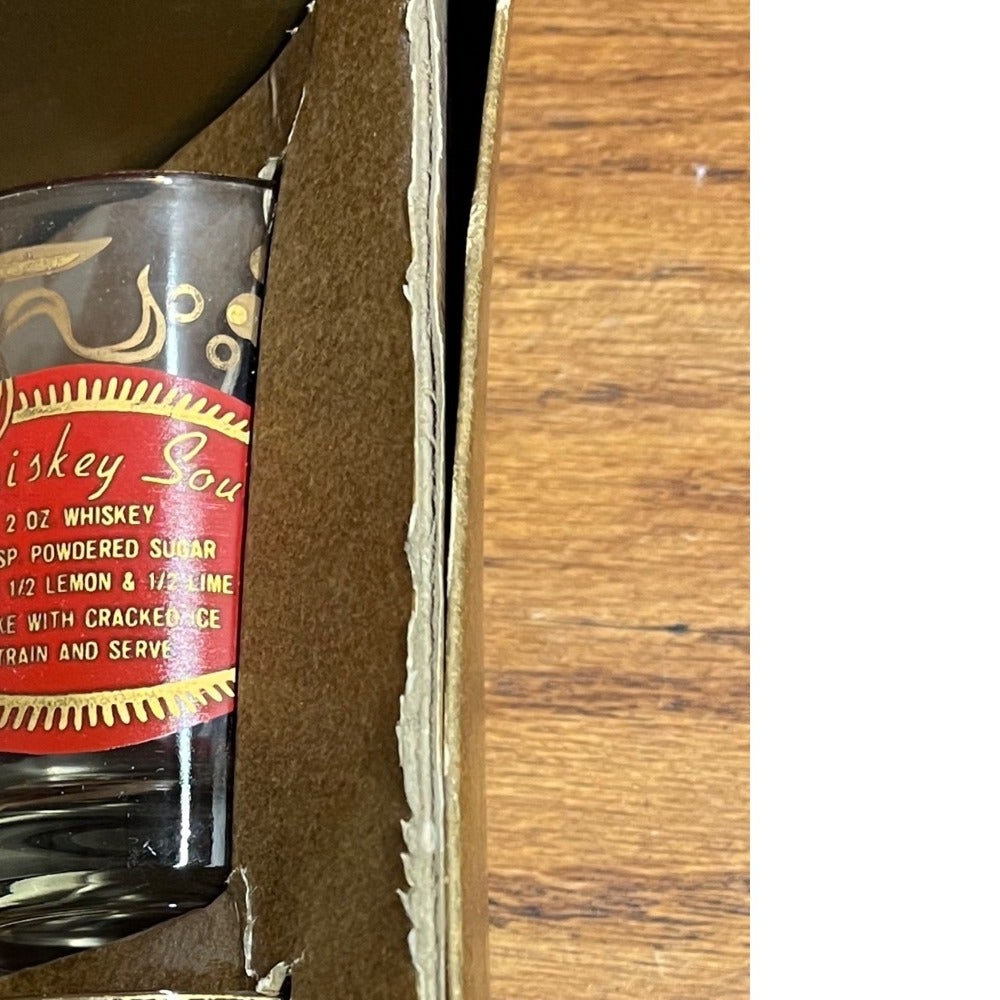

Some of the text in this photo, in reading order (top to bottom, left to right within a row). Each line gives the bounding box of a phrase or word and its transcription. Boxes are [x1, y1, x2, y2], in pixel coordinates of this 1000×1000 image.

[5, 503, 156, 534] 2 OZ WHISKEY
[31, 537, 140, 564] POWDERED
[149, 537, 217, 560] SUGAR
[9, 577, 36, 598] 1/2
[45, 570, 113, 596] LEMON
[122, 570, 136, 592] &
[148, 570, 179, 592] 1/2
[187, 572, 235, 595] LIME
[27, 608, 75, 632] WITH
[84, 605, 180, 630] CRACKED
[58, 640, 100, 662] AND
[108, 638, 173, 661] SERVE
